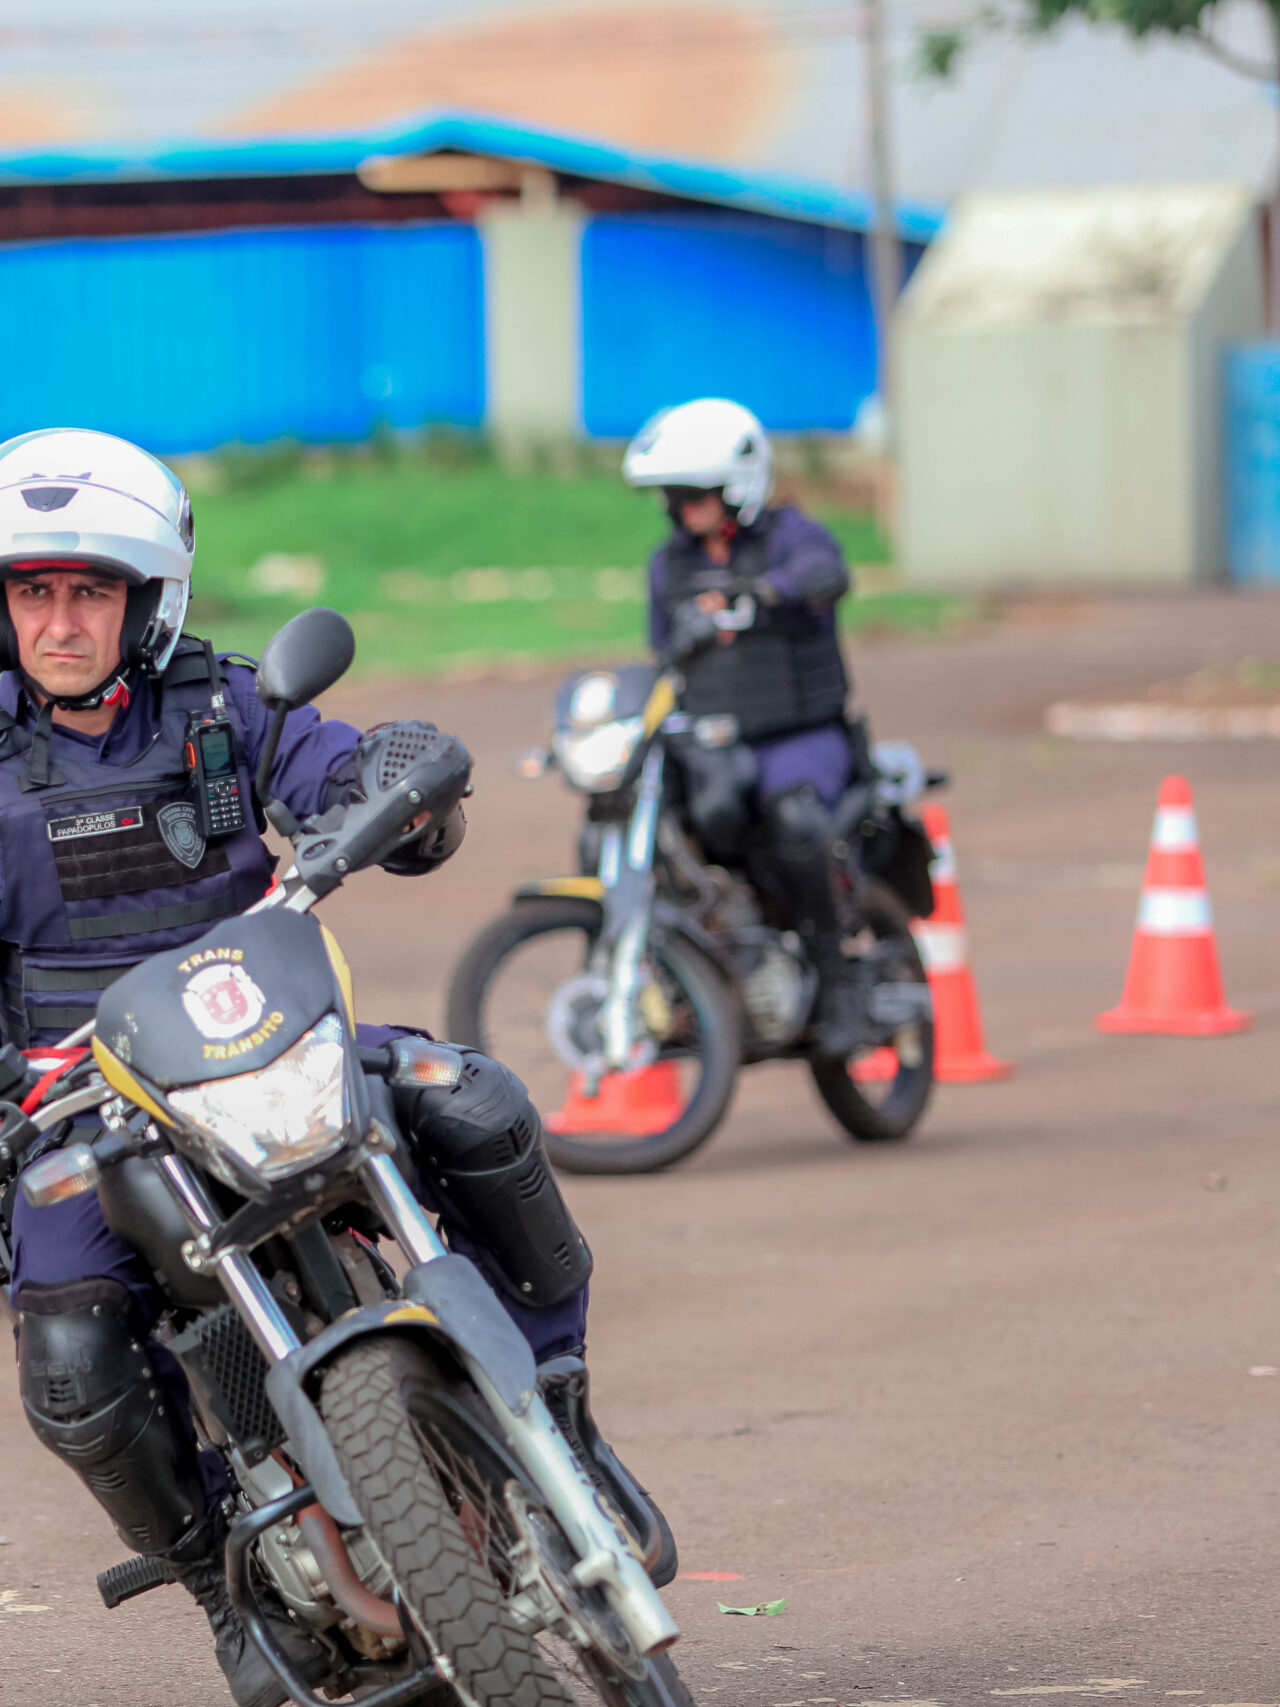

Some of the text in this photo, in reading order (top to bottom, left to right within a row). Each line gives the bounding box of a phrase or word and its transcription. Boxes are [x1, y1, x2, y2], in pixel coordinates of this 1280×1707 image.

[85, 813, 115, 825] CLASSE
[56, 820, 116, 837] PAPADOPULOS
[177, 946, 244, 973] TRANS
